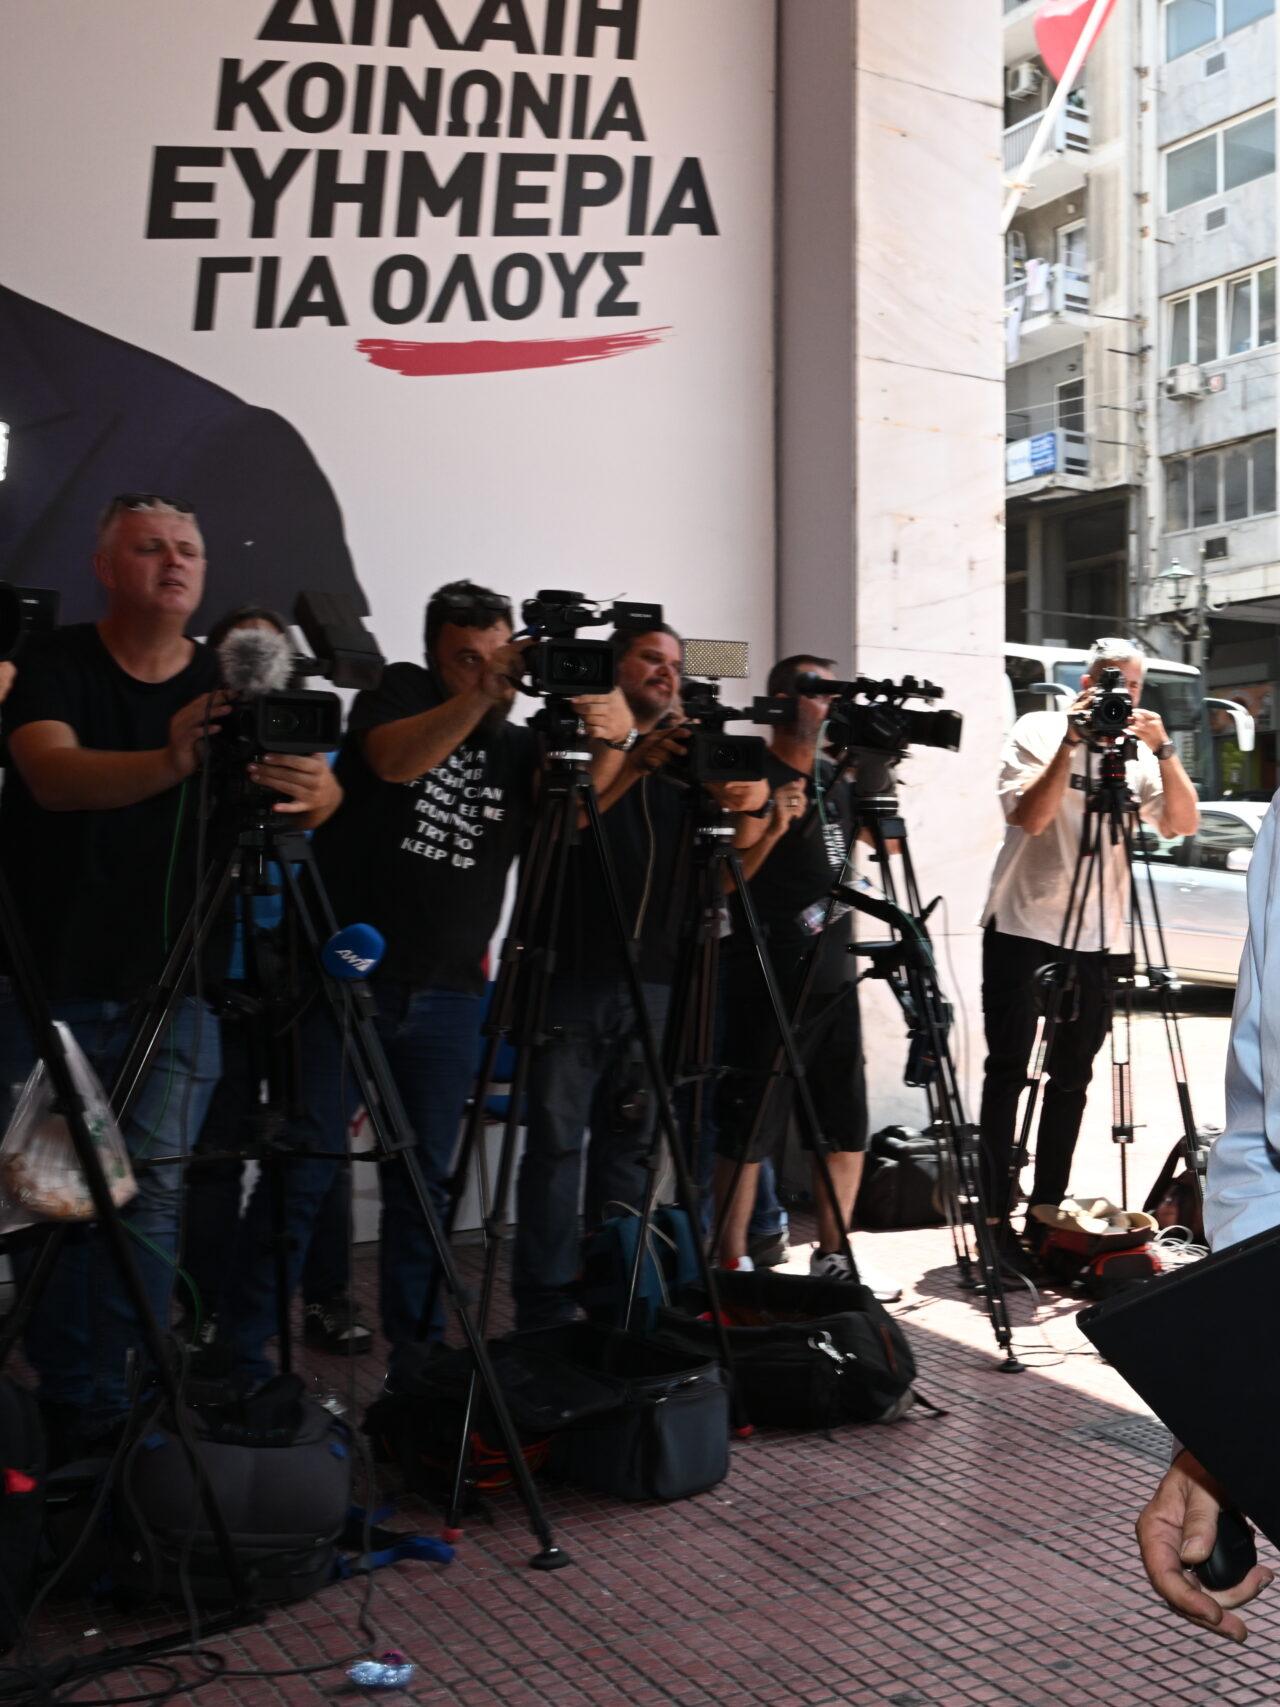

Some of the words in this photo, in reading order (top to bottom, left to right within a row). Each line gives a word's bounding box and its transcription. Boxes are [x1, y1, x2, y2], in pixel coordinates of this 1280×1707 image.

[257, 0, 640, 60] ΔΙΚΑΙΗ
[214, 57, 647, 142] ΚΟΙΝΩΝΙΑ
[145, 145, 720, 240] ΕΥΗΜΕΡΙΑ
[192, 255, 349, 332] ΓΙΑ
[371, 251, 644, 326] ΟΛΟΥΣ
[425, 780, 457, 806] YOU
[401, 837, 448, 861] KEEP
[452, 853, 476, 869] UP
[417, 820, 450, 842] TRY
